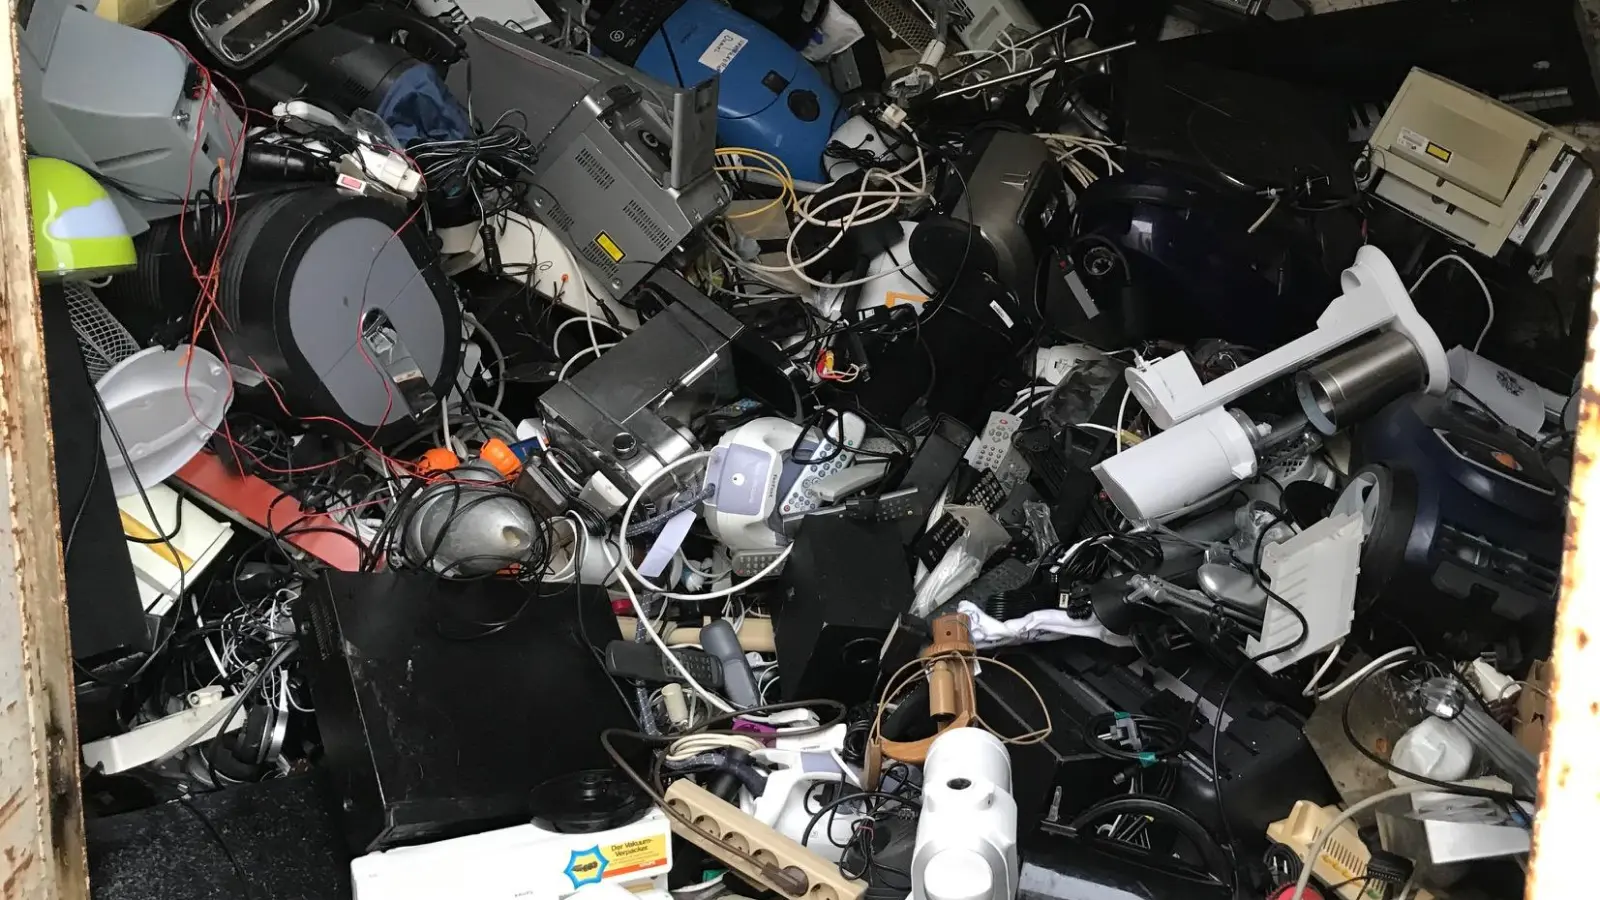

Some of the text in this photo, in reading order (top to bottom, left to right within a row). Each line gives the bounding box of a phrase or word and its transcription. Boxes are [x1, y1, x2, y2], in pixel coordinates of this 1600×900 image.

[611, 838, 652, 852] Der Vakuum-
[615, 845, 648, 857] Verpacker
